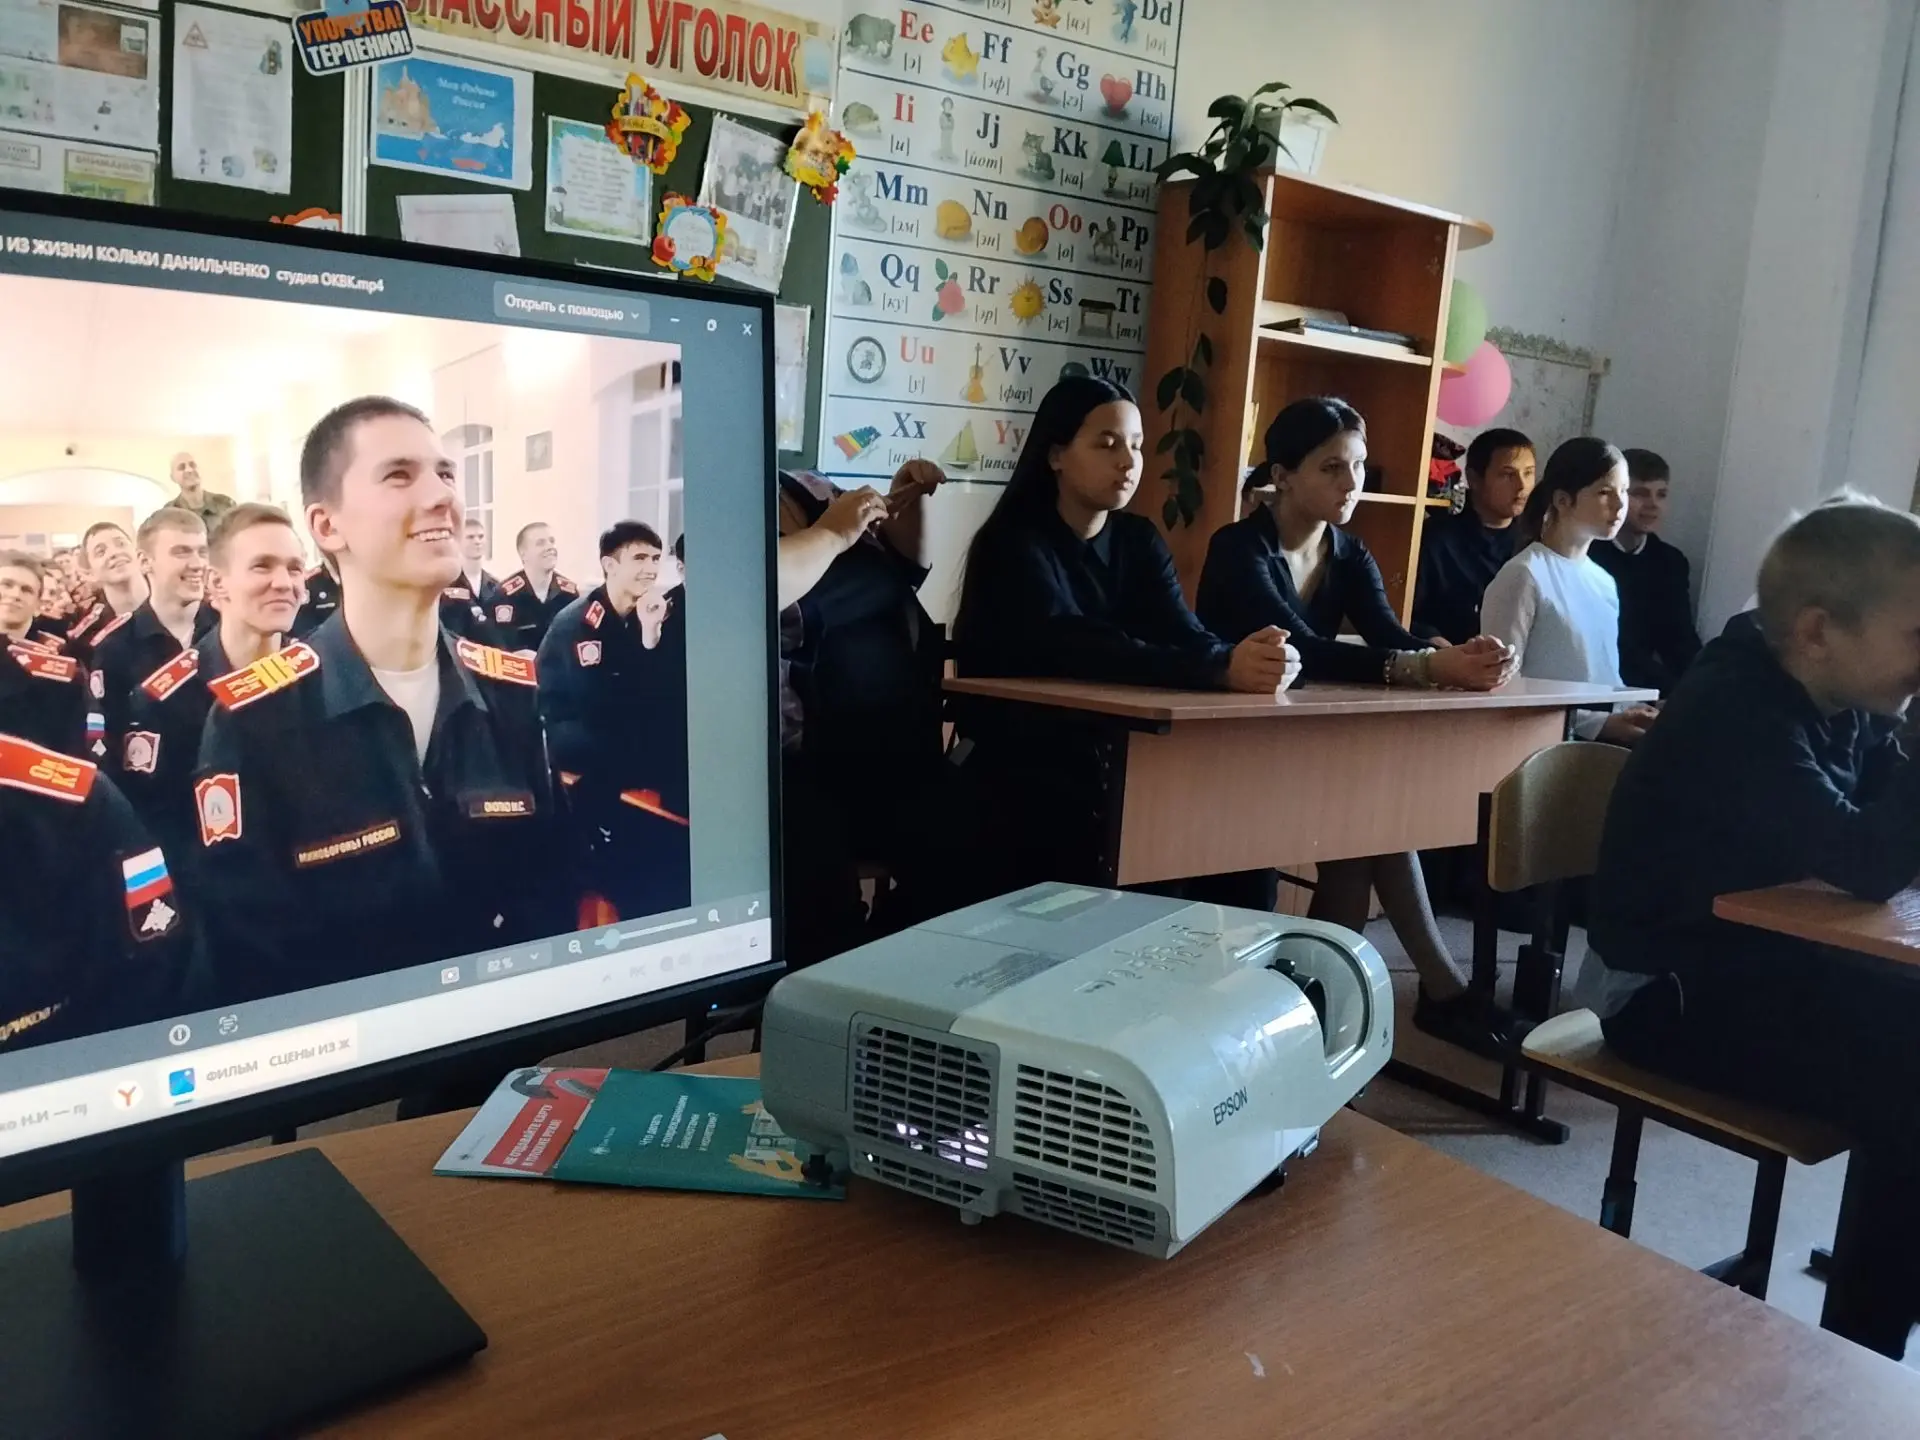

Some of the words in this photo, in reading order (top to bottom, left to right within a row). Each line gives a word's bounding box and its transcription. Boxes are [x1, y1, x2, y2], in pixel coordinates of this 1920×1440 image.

[900, 9, 934, 43] Ee
[1141, 0, 1172, 26] Dd
[307, 30, 411, 70] ТЕРПЕНИЯ!
[646, 0, 799, 97] УГОЛОК
[982, 31, 1012, 63] Ff
[1056, 51, 1090, 91] Gg
[1134, 69, 1166, 101] Hh
[893, 93, 914, 123] Ii
[976, 112, 1000, 149] Jj
[1052, 127, 1088, 159] Kk
[1128, 143, 1153, 172] Ll
[874, 171, 929, 206] Mm
[972, 189, 1008, 220] Nn
[1049, 204, 1082, 233] Oo
[1120, 216, 1149, 251] Pp
[6, 236, 30, 253] ИЗ
[32, 239, 94, 260] ЖИЗНИ
[96, 245, 160, 267] КОЛЬКИ
[161, 253, 270, 279] ДАНИЛЬЧЕНКО
[275, 269, 319, 286] студия
[880, 253, 921, 292] Qq
[967, 265, 1001, 295] Rr
[1048, 278, 1073, 306] Ss
[504, 293, 557, 315] Открыть
[558, 303, 566, 314] с
[567, 306, 624, 321] помощью
[1116, 287, 1141, 315] Tt
[900, 334, 935, 364] Uu
[998, 346, 1033, 375] Vv
[1090, 357, 1132, 386] Ww
[890, 411, 928, 440] Xx
[990, 419, 1026, 453] Yy
[206, 1060, 259, 1082] ФИЛЬМ
[269, 1046, 315, 1067] СЦЕНЫ
[318, 1042, 336, 1056] ИЗ
[338, 1038, 350, 1050] Ж
[1213, 1085, 1248, 1126] EPSON
